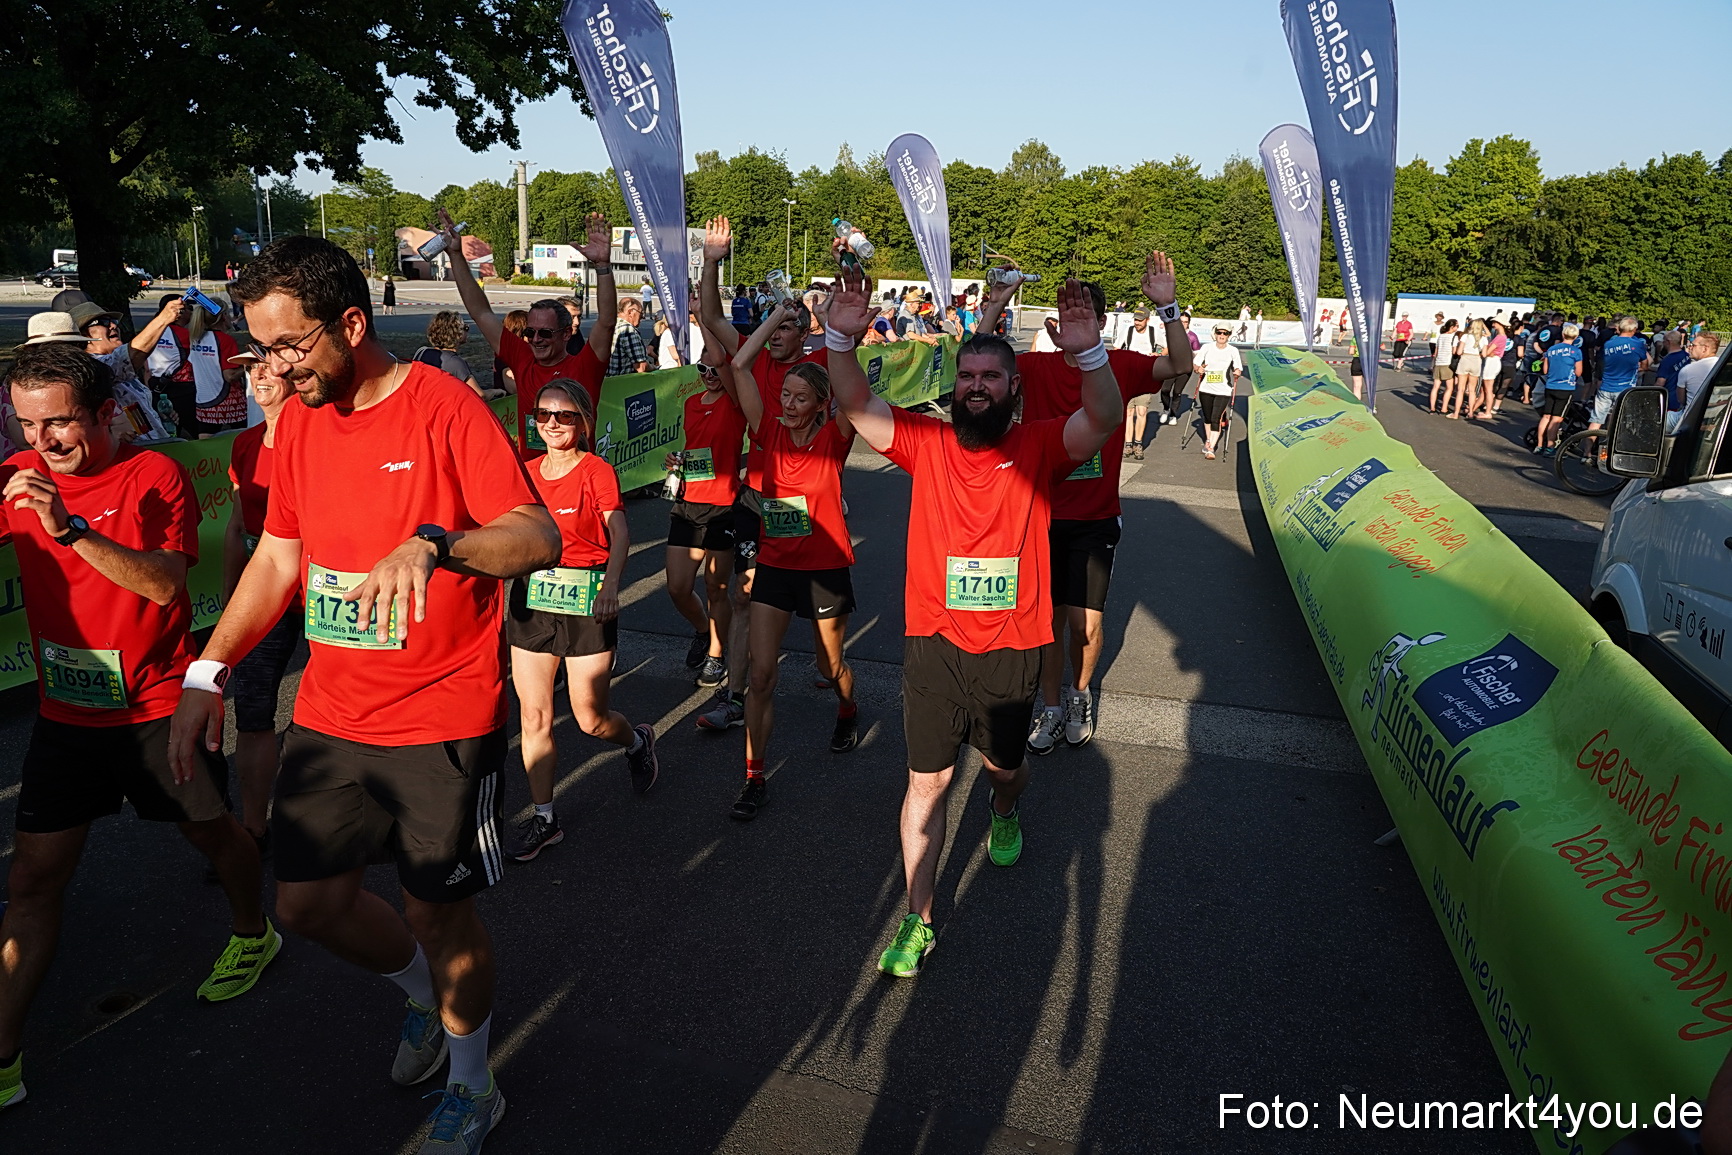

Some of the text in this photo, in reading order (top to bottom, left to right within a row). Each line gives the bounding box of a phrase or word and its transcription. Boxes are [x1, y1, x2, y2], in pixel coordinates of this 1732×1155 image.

[631, 404, 653, 417] Fischer
[614, 415, 682, 465] firmenlauf
[615, 456, 646, 475] neumarkt
[768, 511, 800, 525] 1720
[801, 512, 809, 530] 2022
[1295, 492, 1357, 553] firmenlauf
[1383, 489, 1469, 554] Gesunde Firmen
[1363, 515, 1450, 578] laufen länger!
[322, 582, 349, 592] Firmenlauf
[538, 581, 578, 600] 1714
[552, 599, 576, 607] Corinna
[959, 576, 1006, 593] 1710
[1007, 578, 1015, 602] 2022
[308, 599, 316, 626] RUN
[317, 620, 346, 633] Hörteis
[45, 664, 121, 701] RUN 1694 2022
[1462, 677, 1500, 710] AUTOMOBILE
[1471, 664, 1522, 706] Fischer
[1381, 734, 1419, 800] neumarkt
[1382, 674, 1521, 863] firmenlauf
[1576, 728, 1680, 846] Gesunde
[446, 869, 471, 885] adidas
[1551, 824, 1666, 936] laufen
